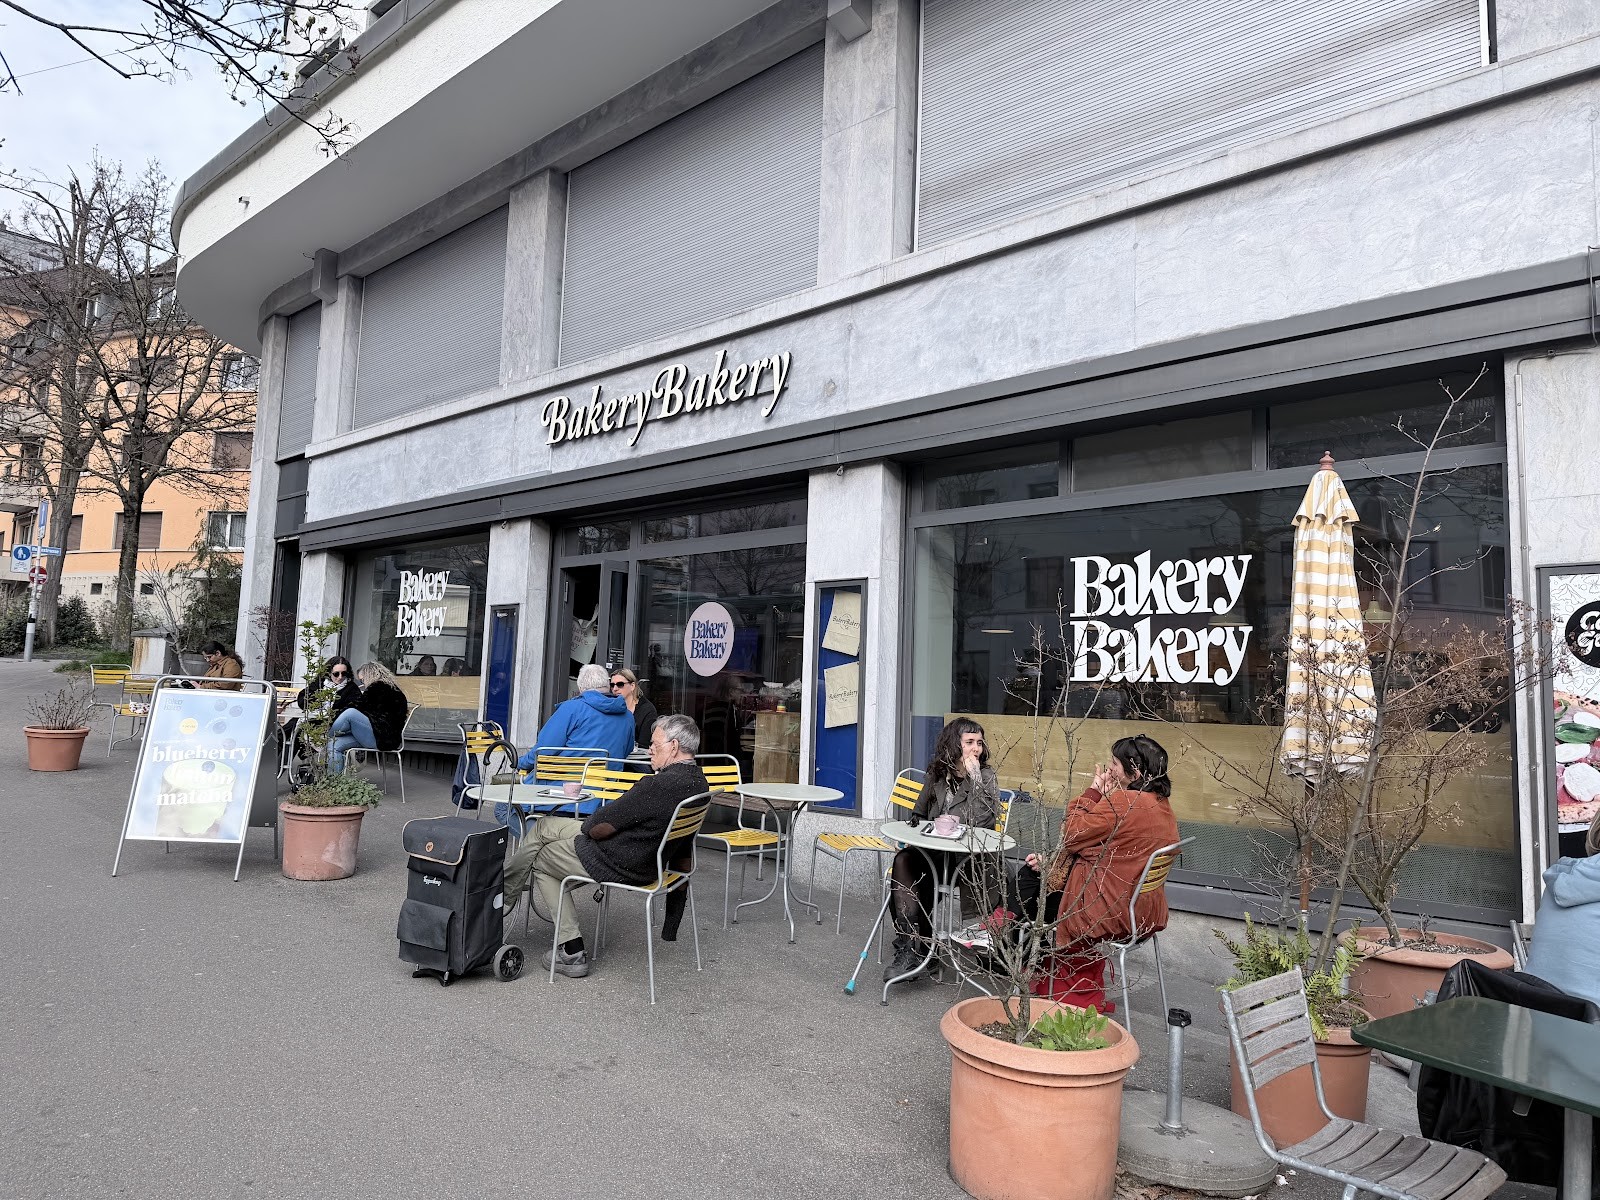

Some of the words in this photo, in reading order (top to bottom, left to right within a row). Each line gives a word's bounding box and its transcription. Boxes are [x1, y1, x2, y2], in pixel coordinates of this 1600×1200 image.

[398, 567, 450, 603] Bakery
[1069, 549, 1253, 618] Bakery
[395, 602, 448, 637] Bakery
[691, 620, 729, 639] Bakery
[690, 639, 728, 659] Bakery
[1069, 616, 1253, 687] Bakery
[152, 744, 251, 764] blueberry
[156, 789, 233, 806] matcha
